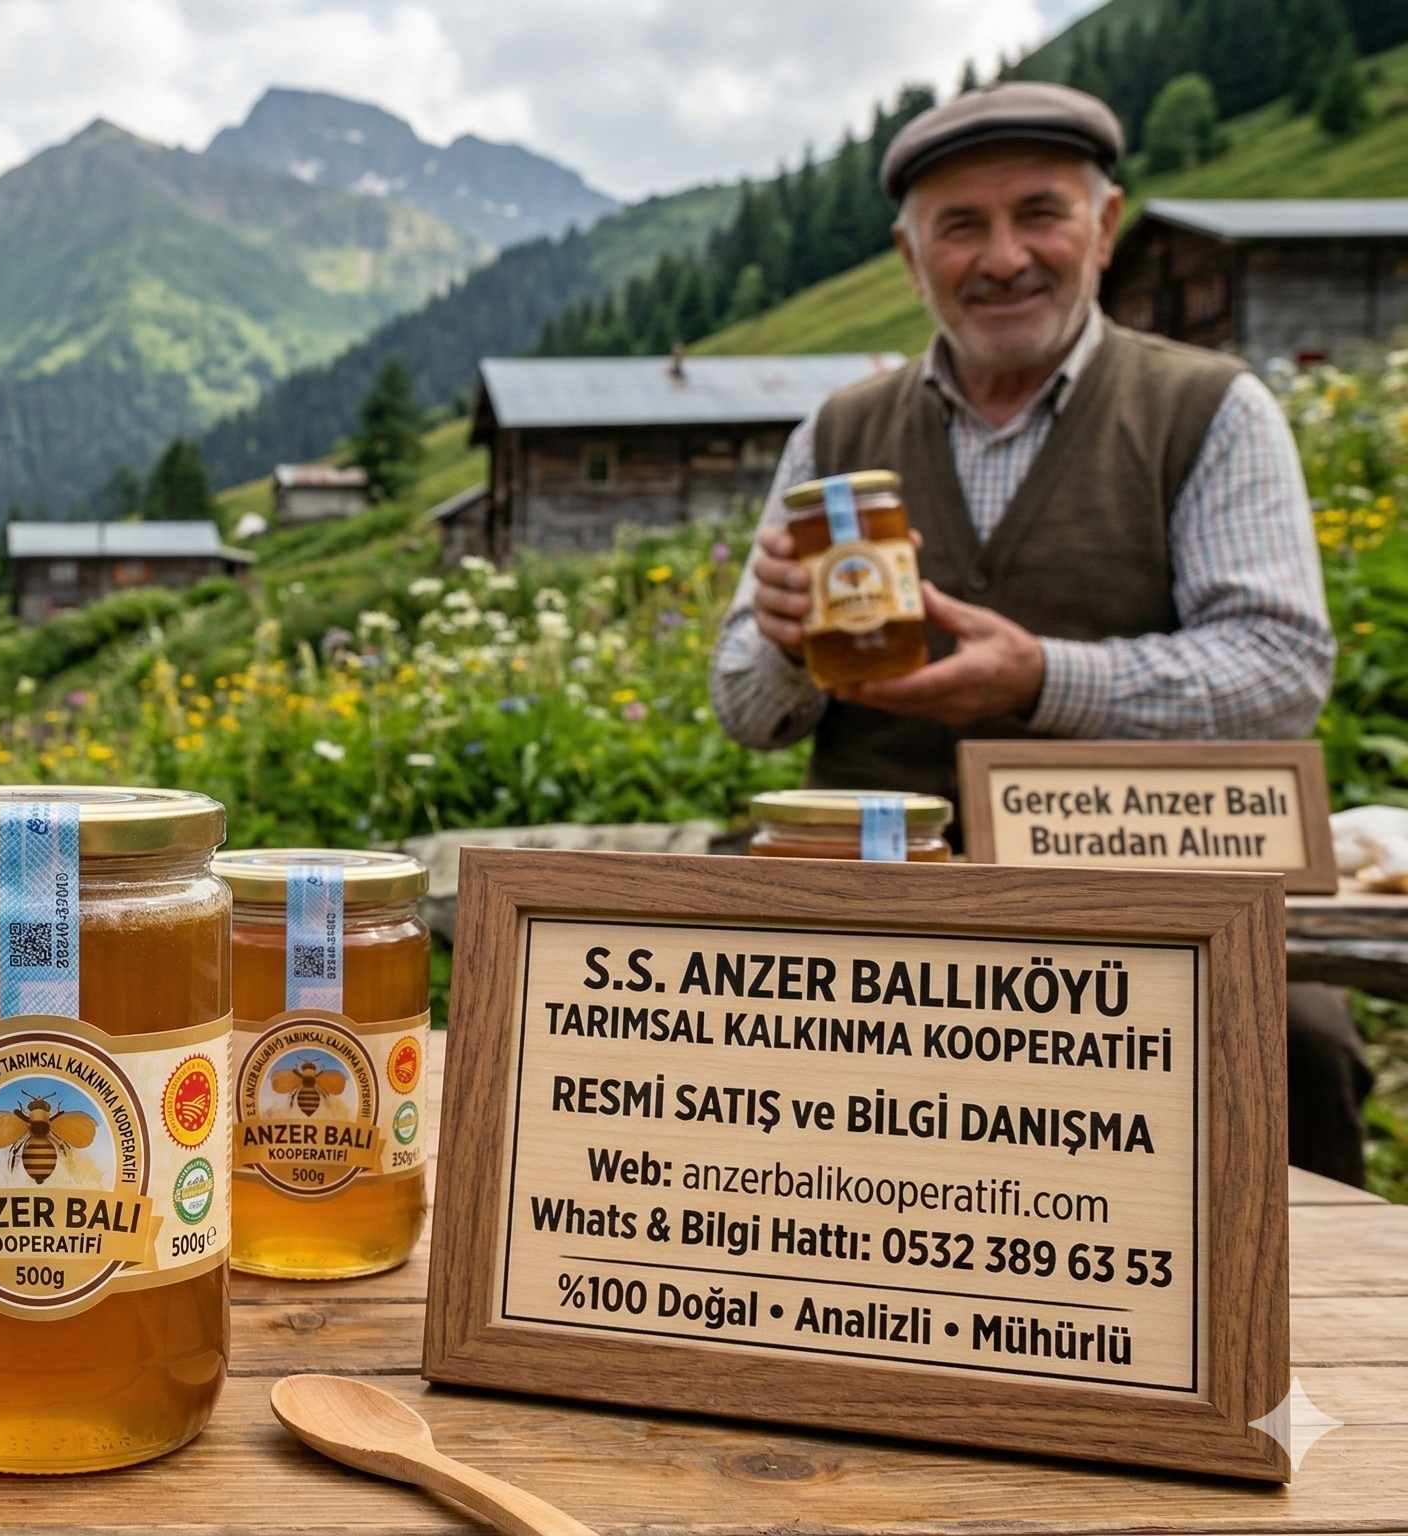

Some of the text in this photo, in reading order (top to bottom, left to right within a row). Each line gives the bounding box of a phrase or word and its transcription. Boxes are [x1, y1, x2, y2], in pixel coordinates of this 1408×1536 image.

[1002, 784, 1288, 819] Gerçek Anzer Balı
[1030, 826, 1267, 857] Buradan Alınır
[583, 946, 1129, 1018] S.S. ANZER BALLIKÖYÜ
[545, 1002, 1172, 1073] TARIMSAL KALKINMA KOOPERATİFİ
[0, 1052, 63, 1073] TARIMSAL
[552, 1074, 1155, 1157] RESMİ SATIŞ ve BİLGİ DANIŞMA
[243, 1125, 372, 1149] ANZER BALI
[292, 1168, 325, 1184] 500g
[587, 1147, 1108, 1223] Web: anzerbalikooperatifi.com
[65, 1197, 141, 1233] BALI
[172, 1232, 205, 1257] 500g
[530, 1196, 1173, 1288] Whats & Bilgi Hattı: 0532 389 63 53
[16, 1266, 65, 1289] 500g
[558, 1272, 1132, 1365] %100 Doğal Analizli Mühürlü
